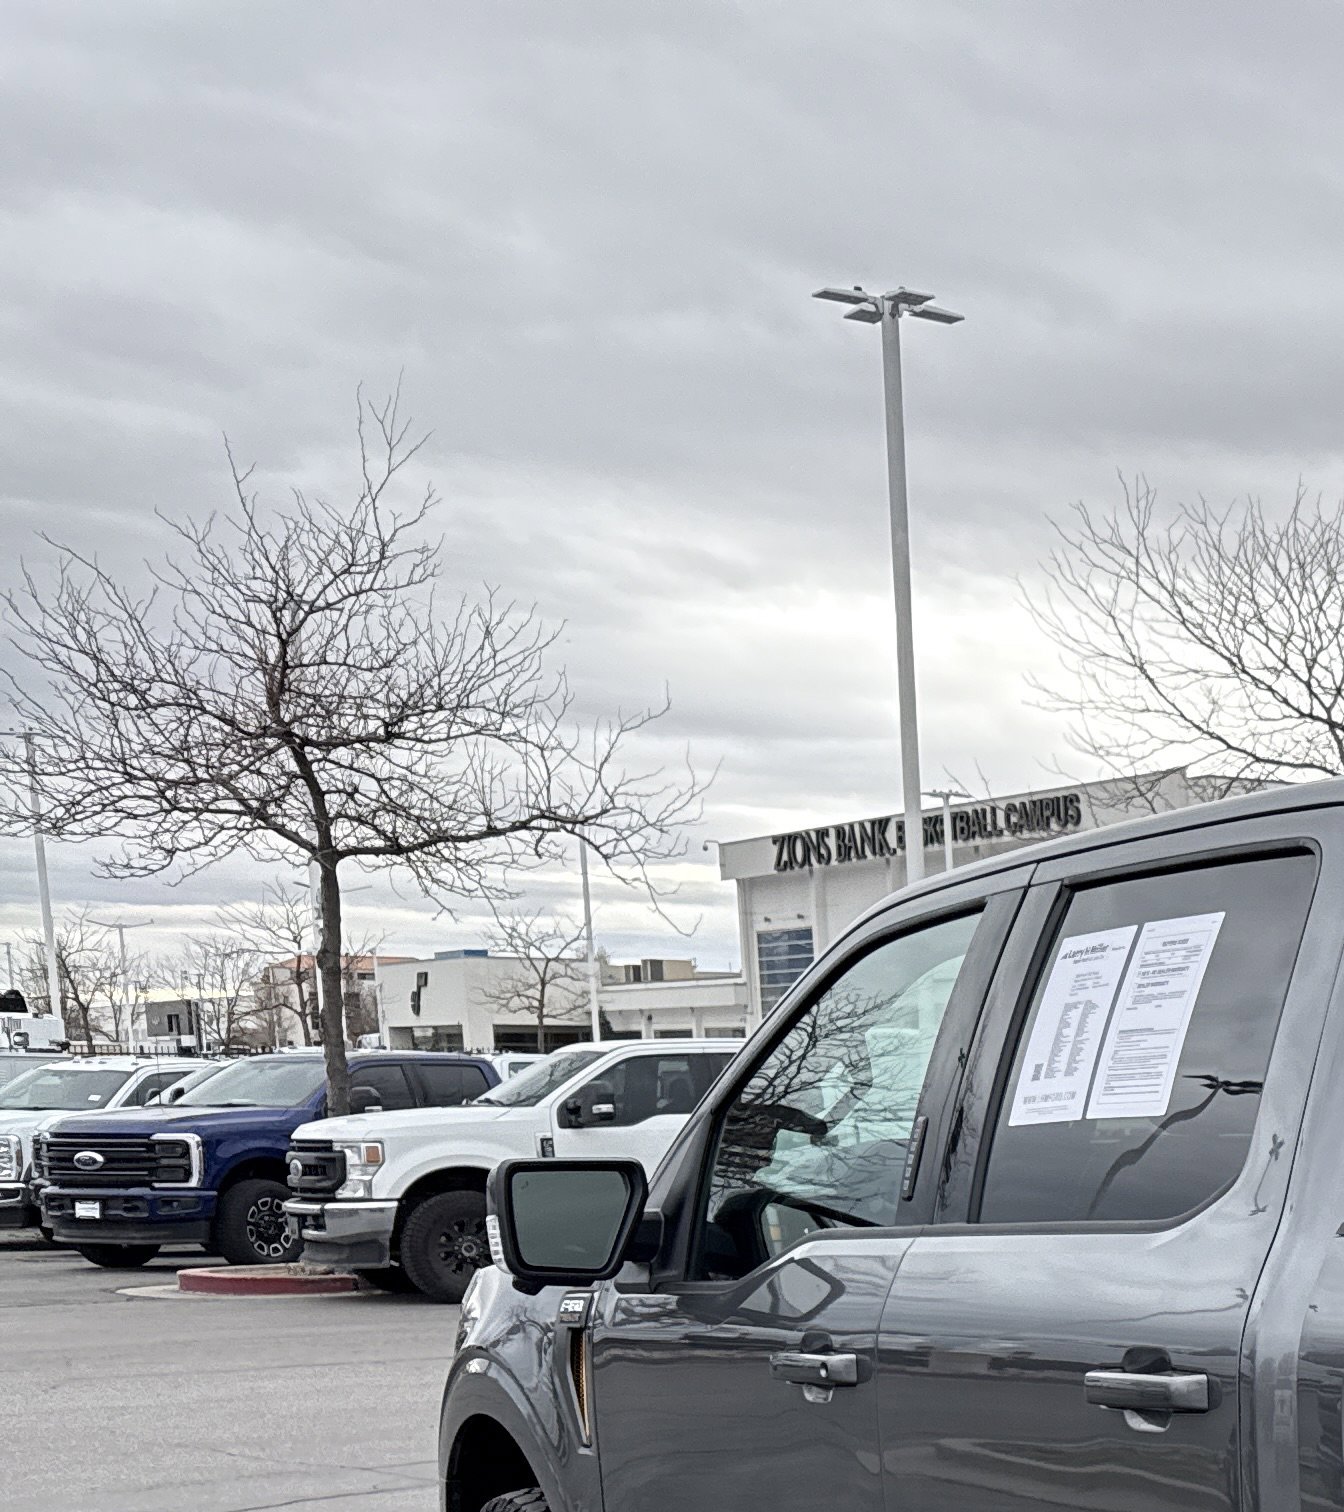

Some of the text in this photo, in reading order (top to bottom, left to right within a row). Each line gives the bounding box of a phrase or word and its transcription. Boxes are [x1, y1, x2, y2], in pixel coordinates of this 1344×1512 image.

[772, 828, 832, 873] ZIONS
[896, 805, 1003, 851] BSKETBALL
[1004, 794, 1082, 835] CAMPUS
